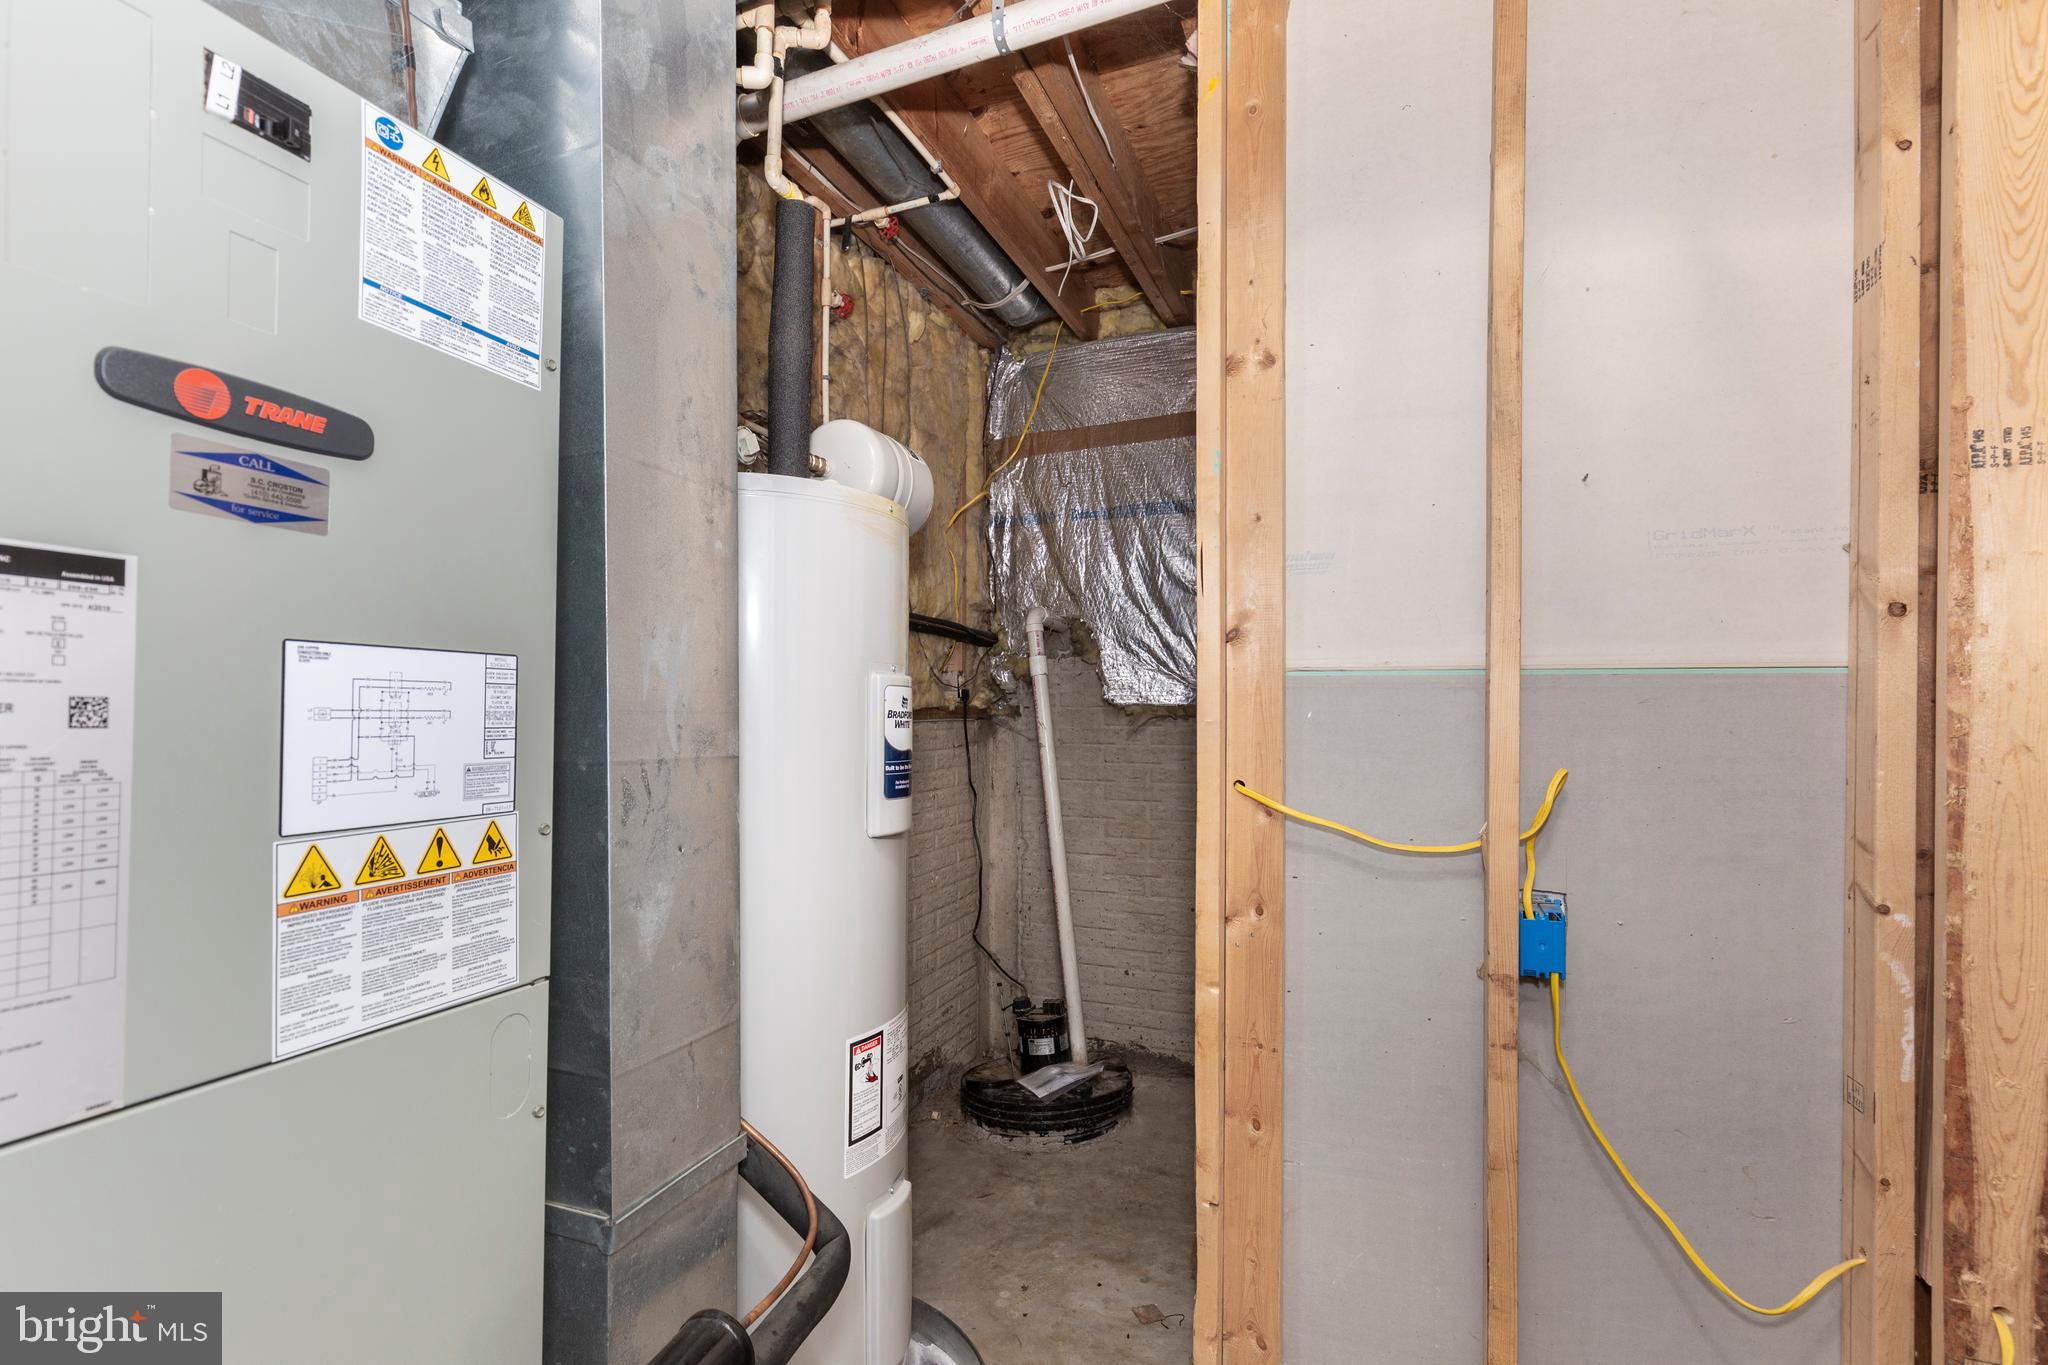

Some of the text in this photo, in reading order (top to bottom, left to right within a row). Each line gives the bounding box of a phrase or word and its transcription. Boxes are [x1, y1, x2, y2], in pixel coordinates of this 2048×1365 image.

[216, 61, 235, 110] L1 L2
[379, 147, 416, 173] WARNING
[499, 215, 541, 245] ADVERTENCIA
[244, 395, 328, 435] TRANE
[238, 456, 275, 473] CALL
[1990, 445, 2000, 468] S-P-F
[231, 503, 280, 521] for service
[895, 720, 910, 729] WHITE
[462, 863, 513, 879] ADVERTENCIA
[375, 875, 447, 896] AVERTISSEMENT
[299, 894, 347, 910] WARNING
[861, 1040, 878, 1051] DANGER
